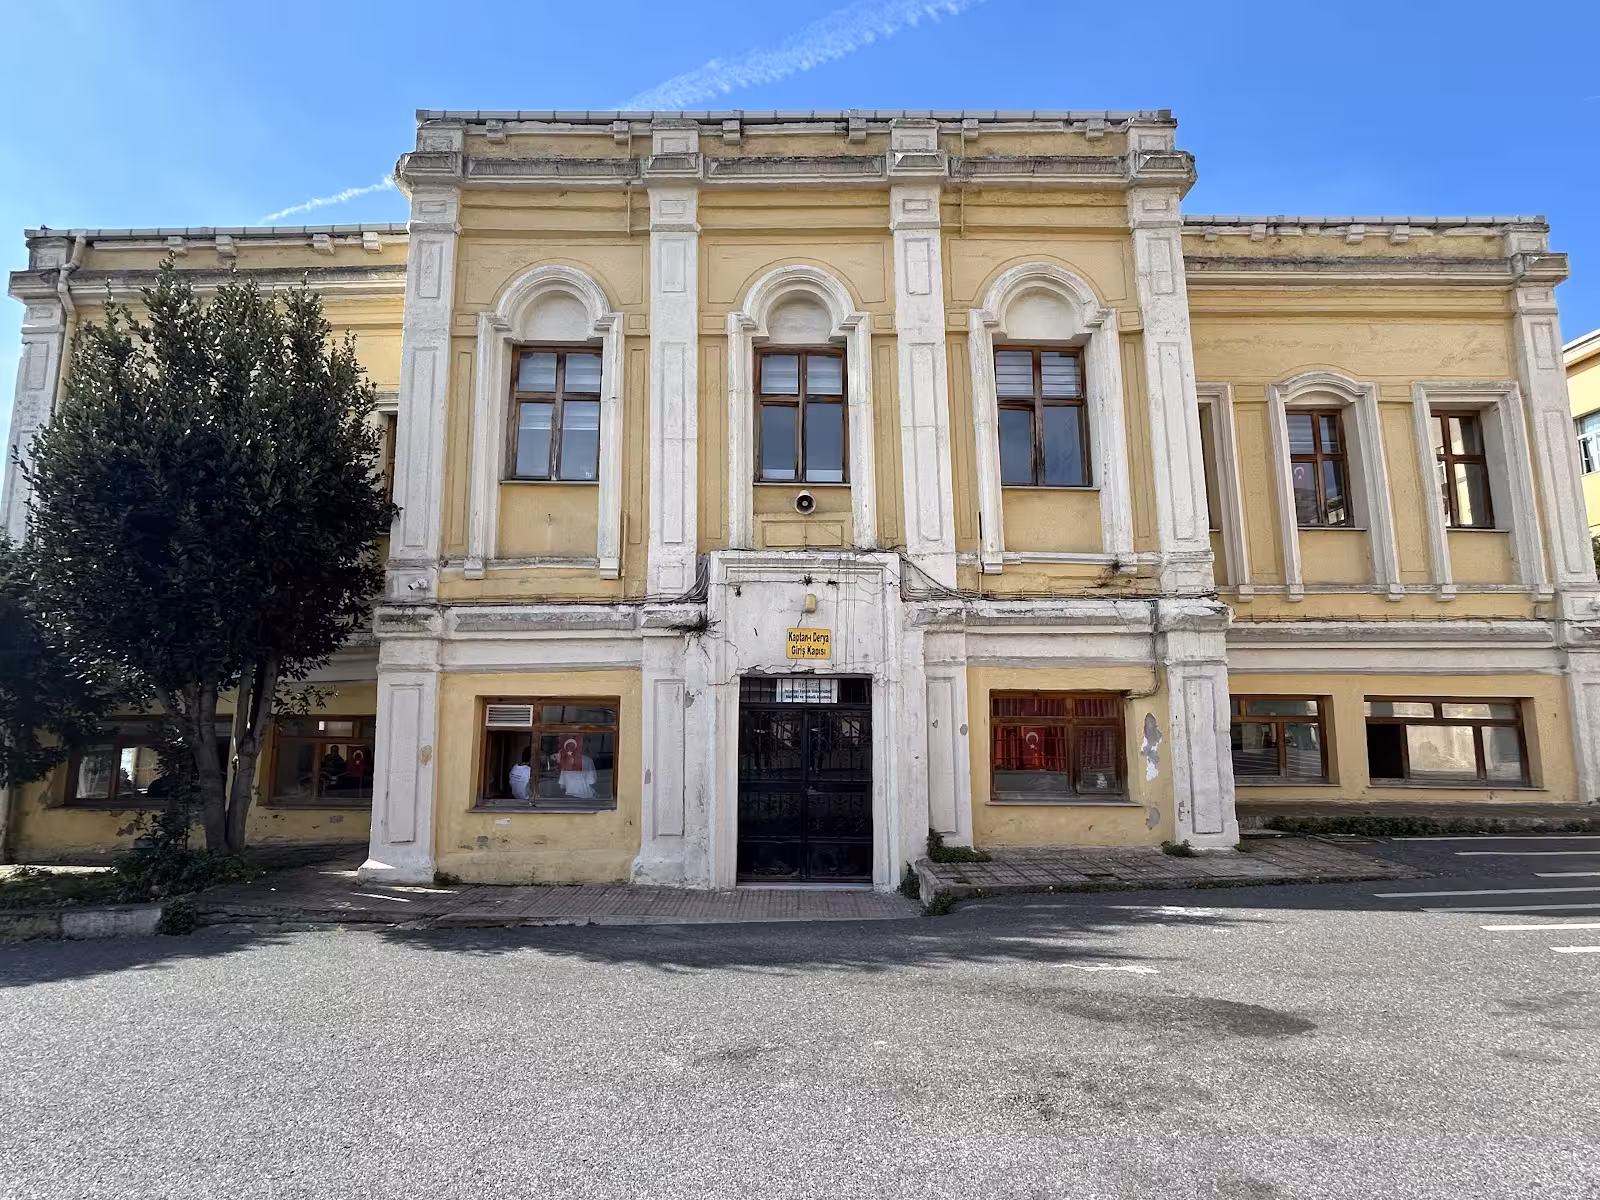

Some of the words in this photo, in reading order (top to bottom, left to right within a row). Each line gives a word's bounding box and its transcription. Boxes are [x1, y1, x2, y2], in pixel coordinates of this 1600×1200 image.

[812, 631, 829, 646] Derya
[791, 645, 806, 658] Giriş
[807, 645, 827, 658] Kapısı
